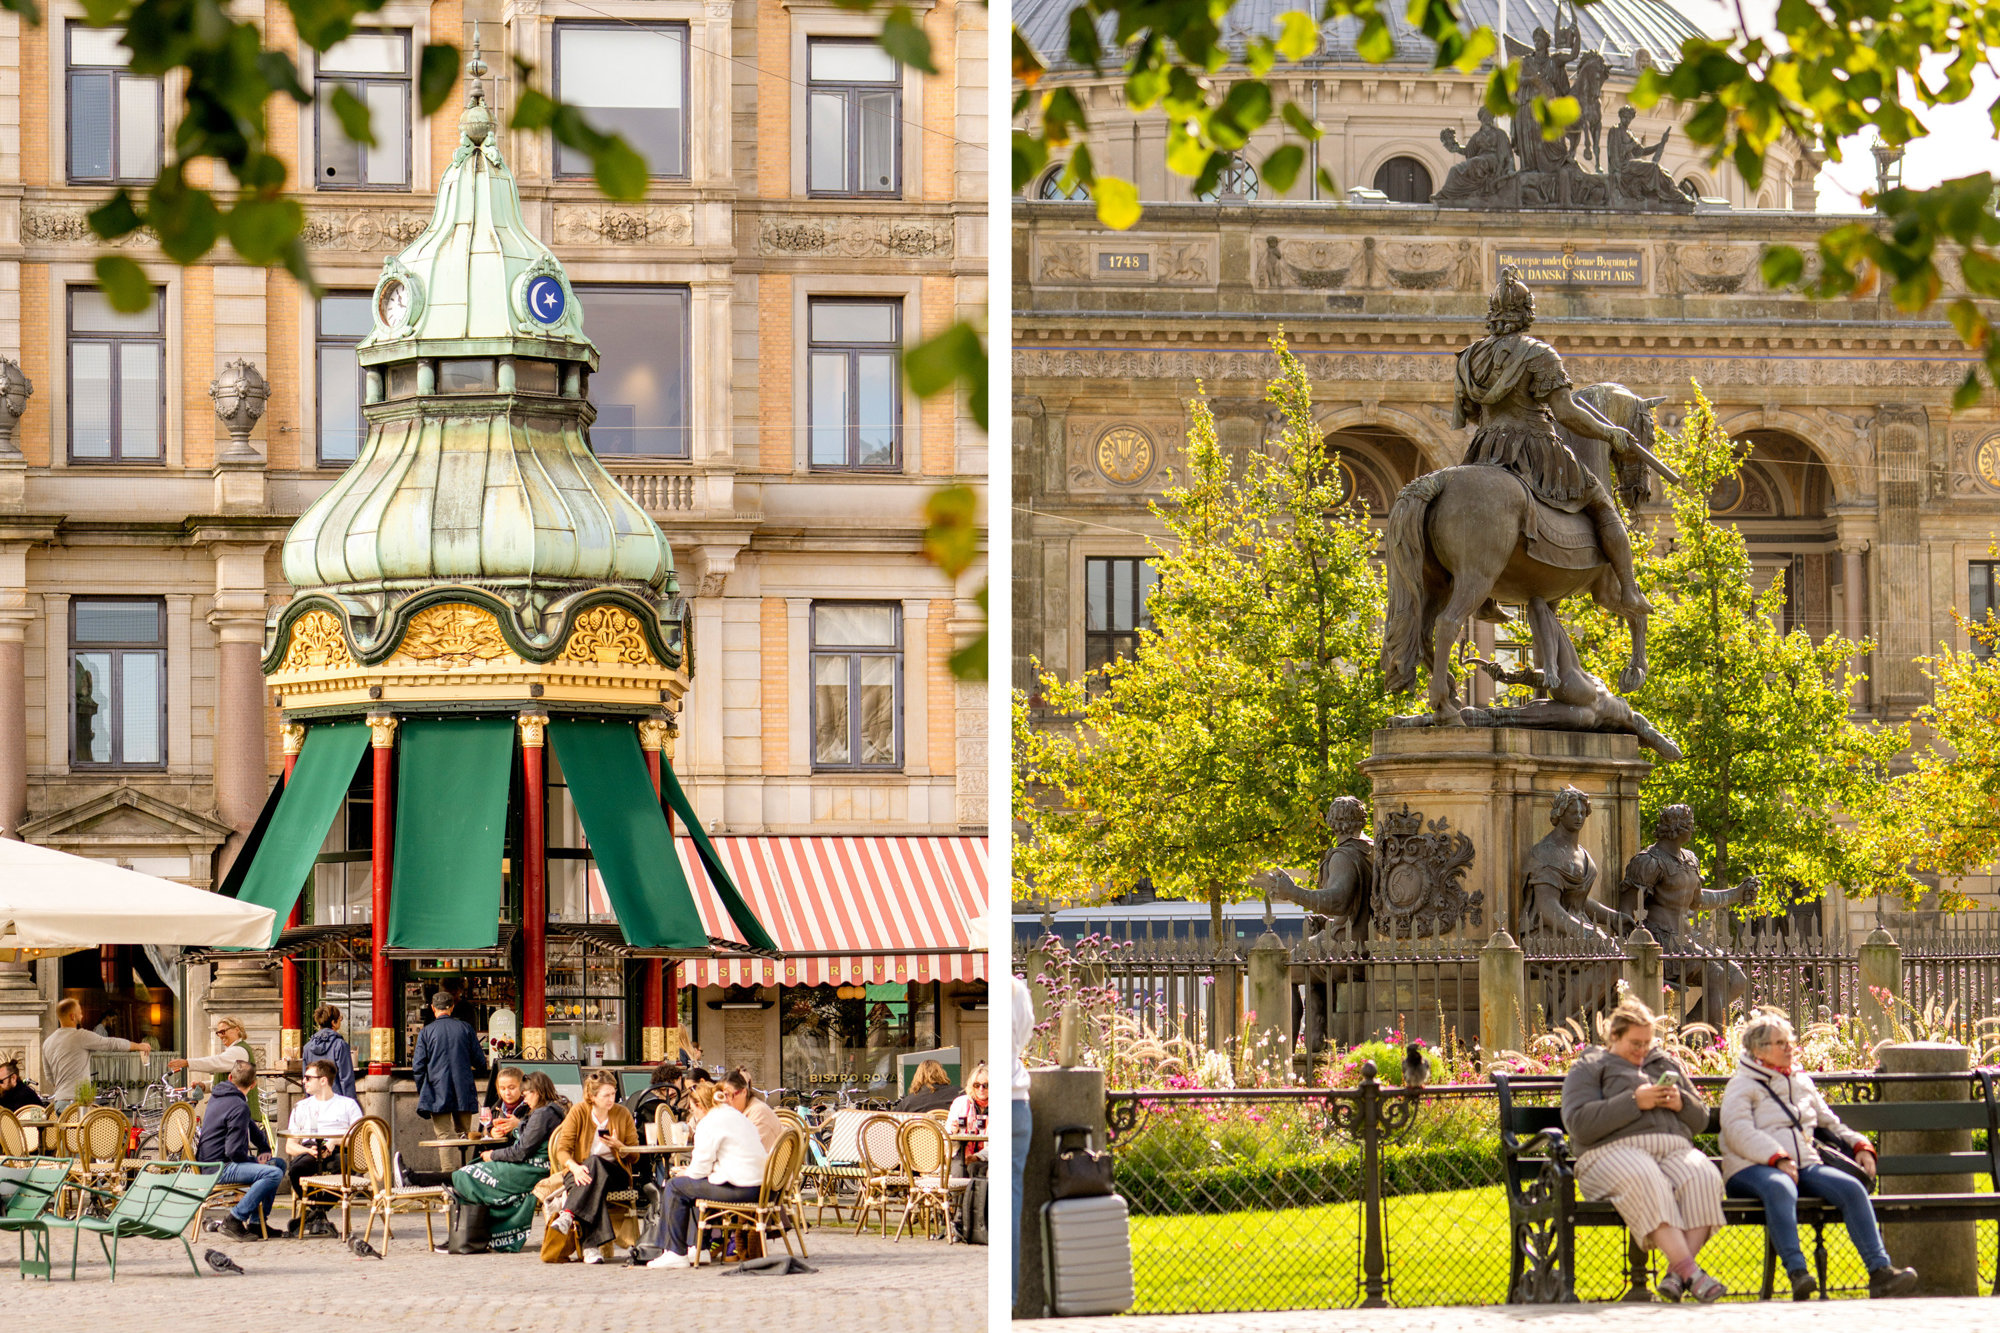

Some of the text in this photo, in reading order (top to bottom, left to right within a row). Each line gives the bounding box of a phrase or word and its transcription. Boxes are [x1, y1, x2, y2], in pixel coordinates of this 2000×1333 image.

[1109, 255, 1140, 268] 1748
[1542, 255, 1561, 265] under
[1574, 256, 1595, 266] denne
[1527, 269, 1568, 280] DANSKE
[1572, 270, 1635, 281] SKUEPLADS
[677, 964, 928, 977] BISTRO ROYAL
[809, 1073, 897, 1083] BISTRO ROYA
